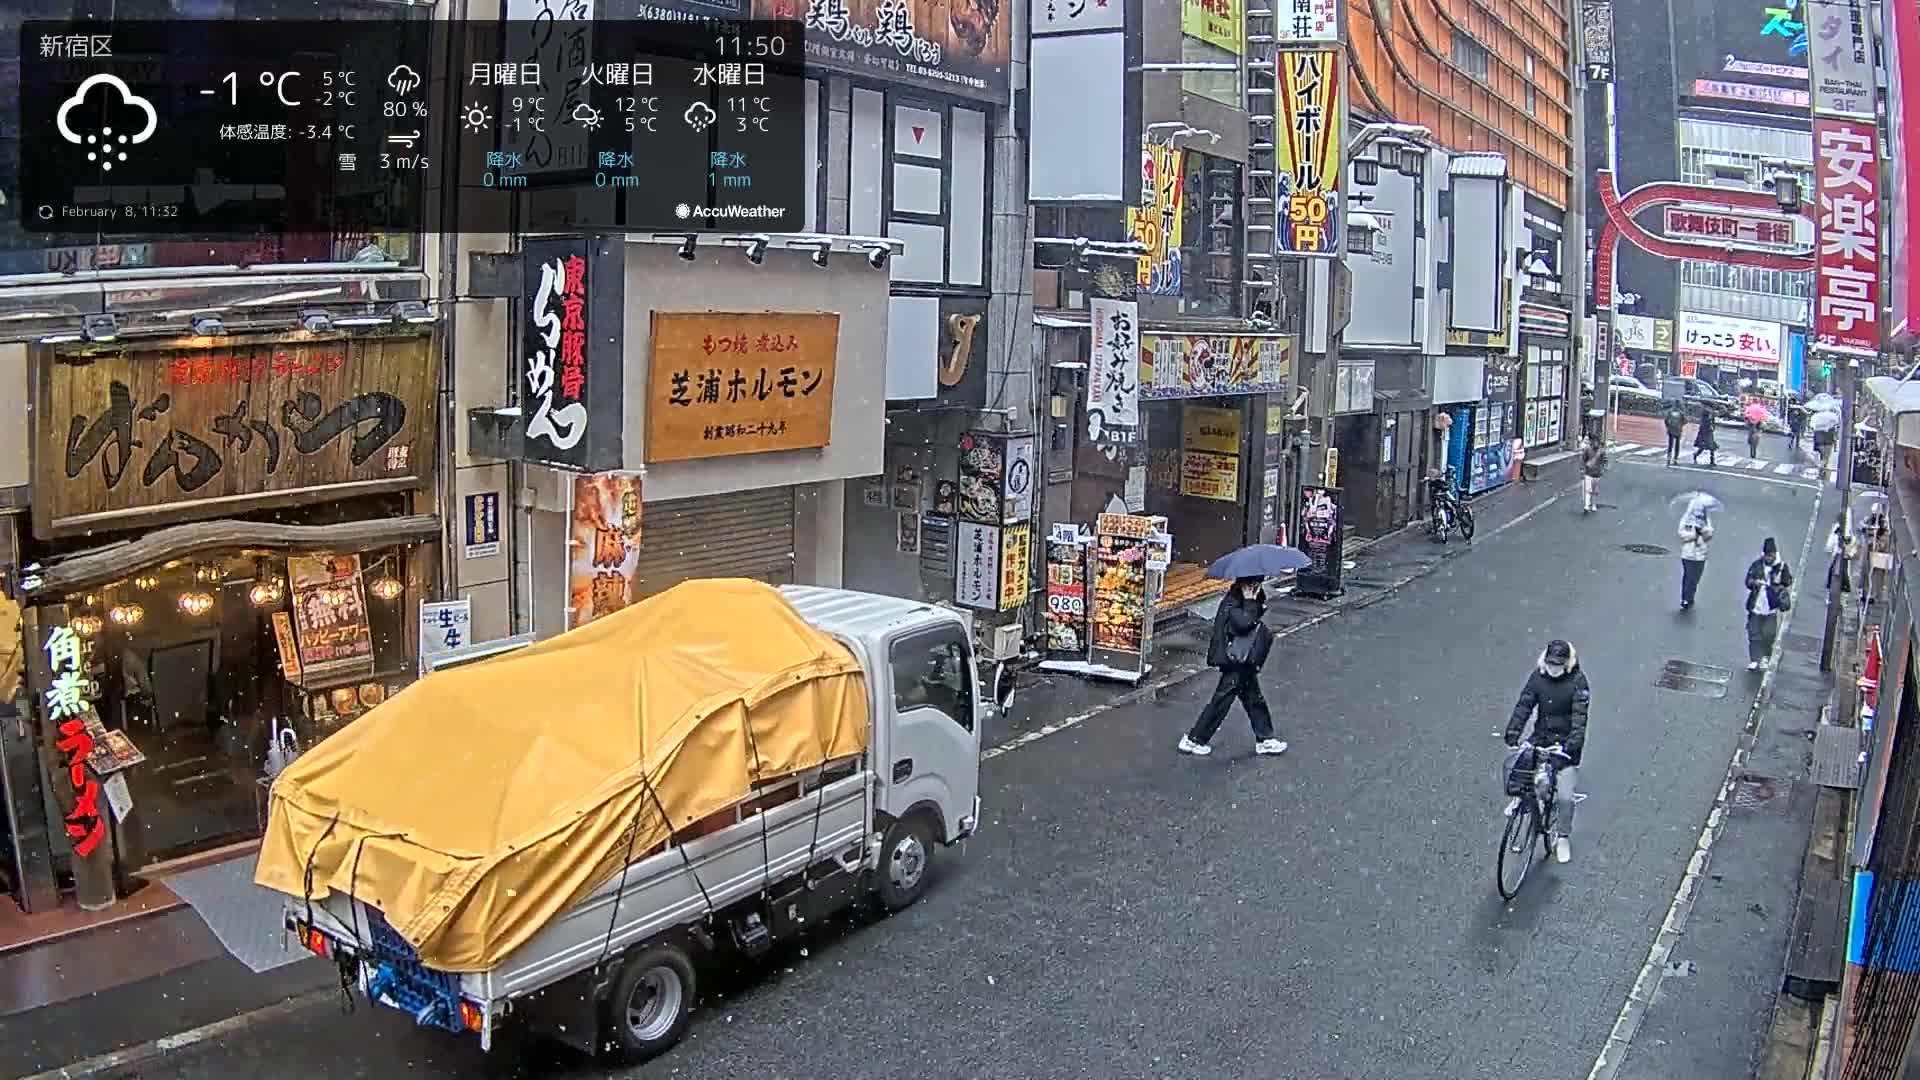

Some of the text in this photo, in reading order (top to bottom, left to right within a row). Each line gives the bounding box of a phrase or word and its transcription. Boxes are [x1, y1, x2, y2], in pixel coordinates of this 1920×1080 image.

[1589, 65, 1610, 80] 7F
[1295, 55, 1322, 190] ハイボール
[1289, 197, 1328, 251] 50円
[1670, 213, 1790, 243] 歌舞伎町一番街
[1819, 127, 1876, 331] 安楽亭
[561, 254, 585, 399] 東京豚骨
[1685, 329, 1777, 354] けっこう 安い。
[1106, 310, 1136, 414] お好み焼き
[668, 367, 824, 407] 芝浦ホルモン
[1048, 595, 1084, 613] 980
[301, 622, 368, 648] ハッピーアワー
